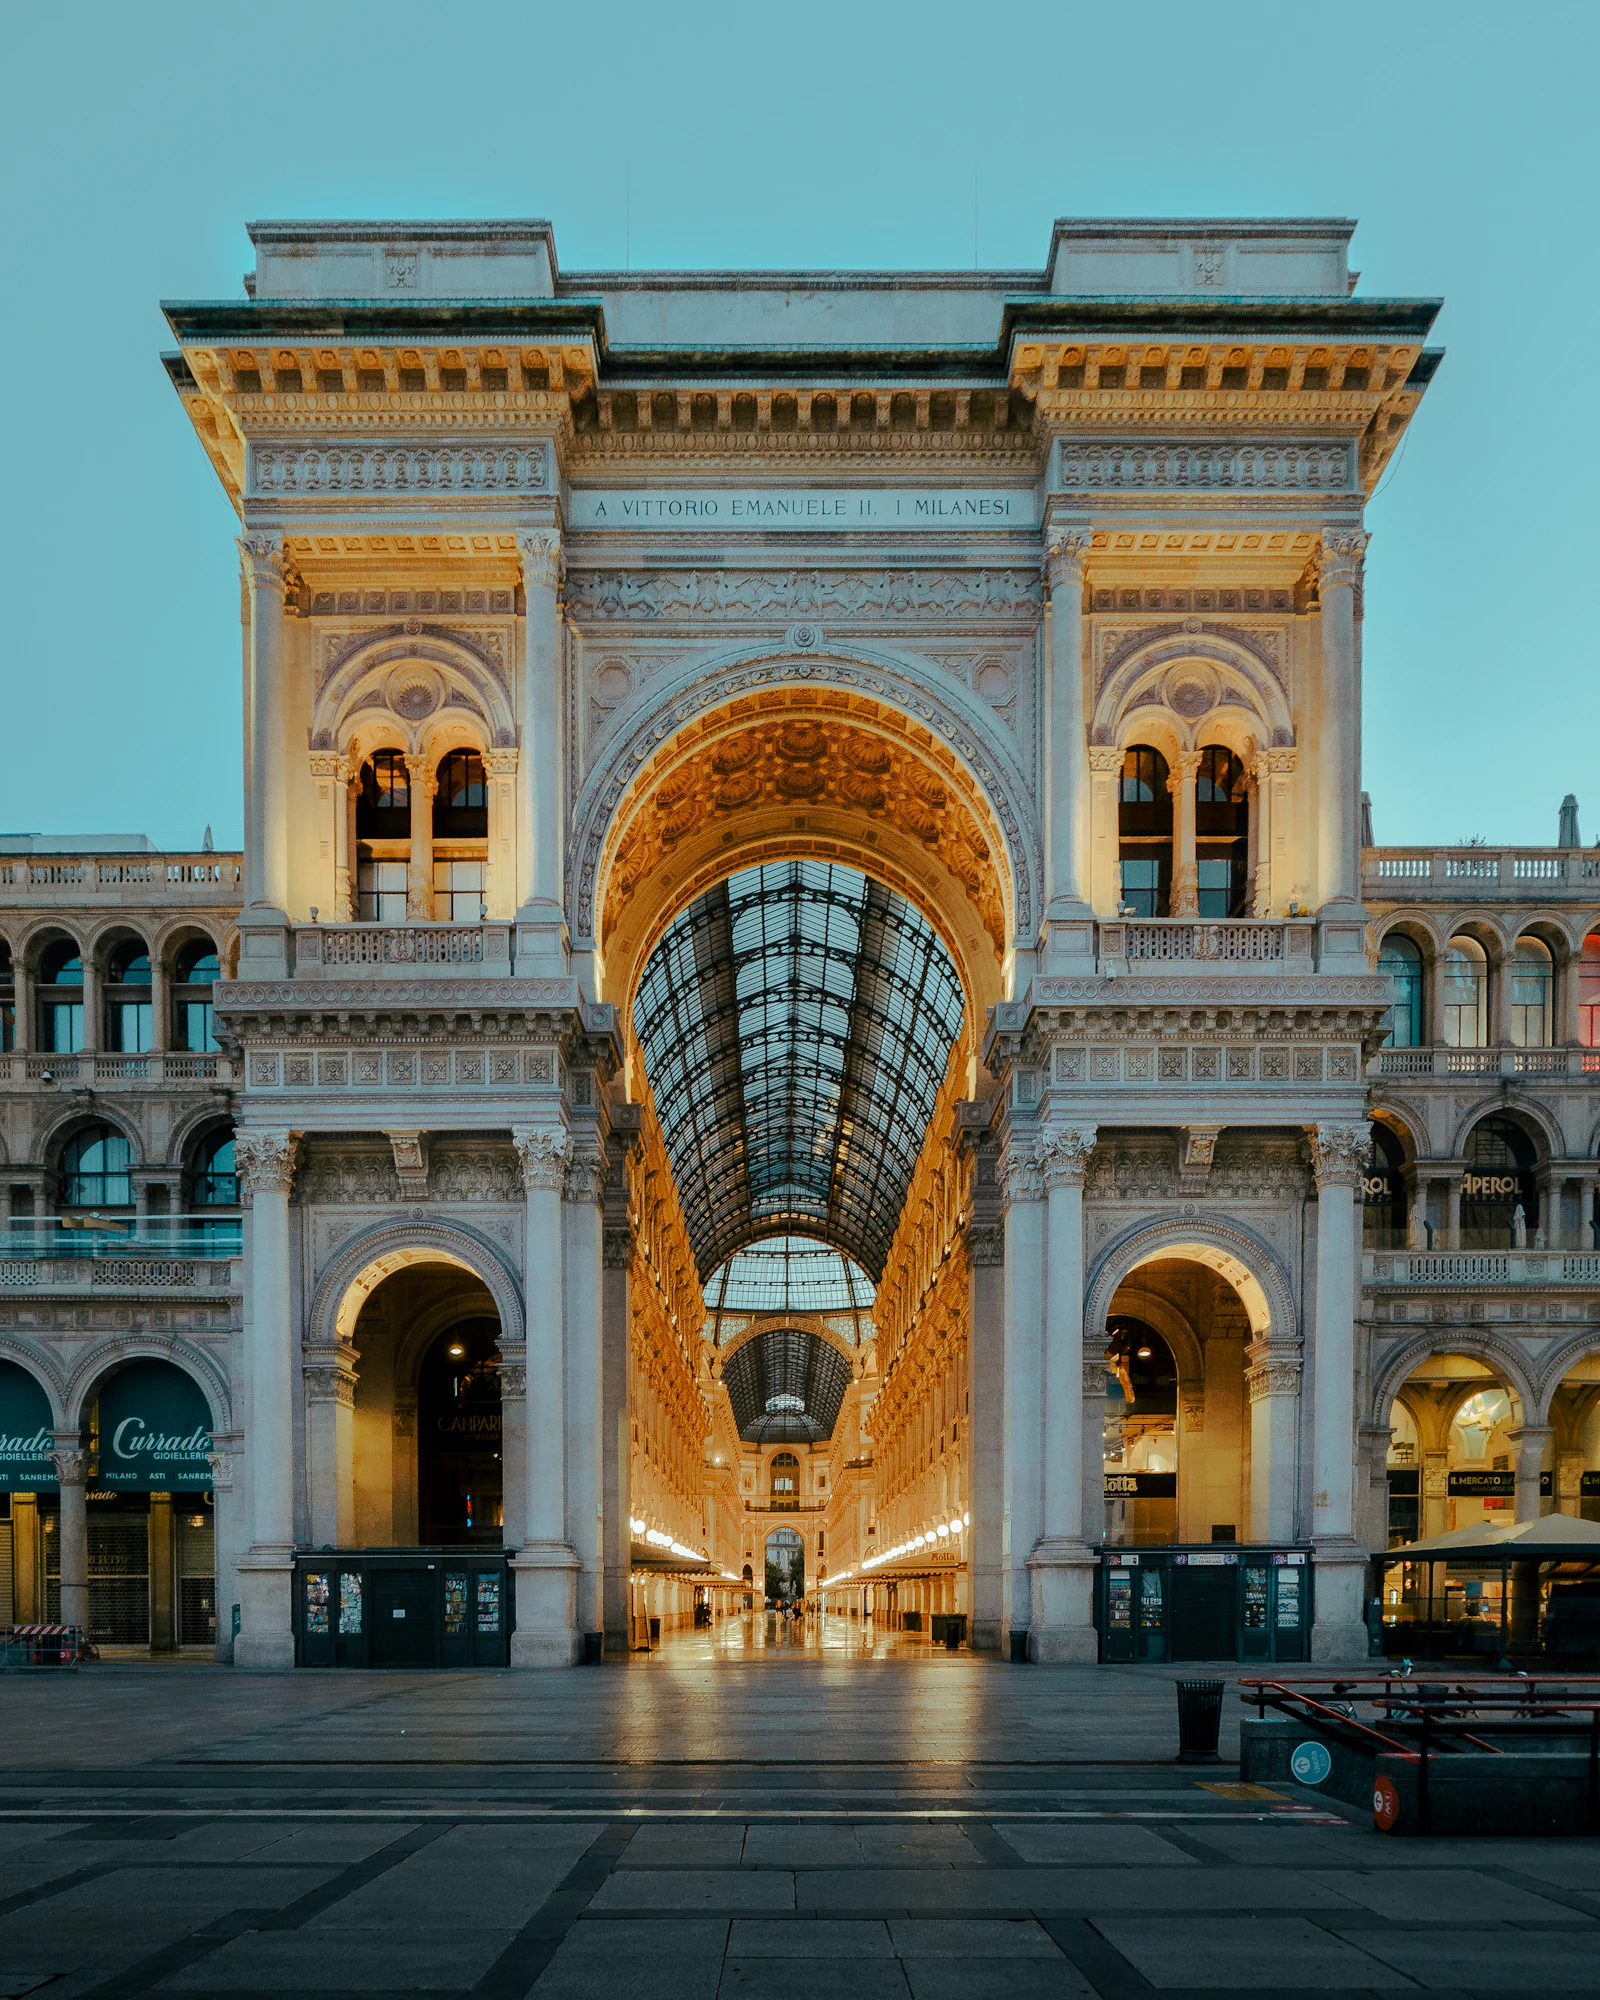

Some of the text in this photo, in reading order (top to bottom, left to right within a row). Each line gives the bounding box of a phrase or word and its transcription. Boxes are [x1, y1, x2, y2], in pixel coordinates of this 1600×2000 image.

[595, 500, 607, 515] A
[622, 500, 718, 515] VITTORIO
[731, 499, 847, 515] EMANUELE
[896, 499, 901, 515] I
[914, 499, 1010, 515] MILANESI
[1363, 1177, 1392, 1195] ROL
[1459, 1173, 1523, 1195] APEROL
[1464, 1194, 1524, 1202] ERRAZZA
[437, 1414, 501, 1431] CAMPARI
[0, 1427, 53, 1451] rado
[113, 1417, 211, 1459] Currado
[0, 1452, 46, 1461] IOIELLERI
[105, 1472, 213, 1480] MILANO ASTI SANREM
[1450, 1476, 1458, 1485] IL
[1459, 1476, 1501, 1485] MERCATO
[85, 1490, 118, 1501] rrado
[931, 1552, 955, 1561] Motta
